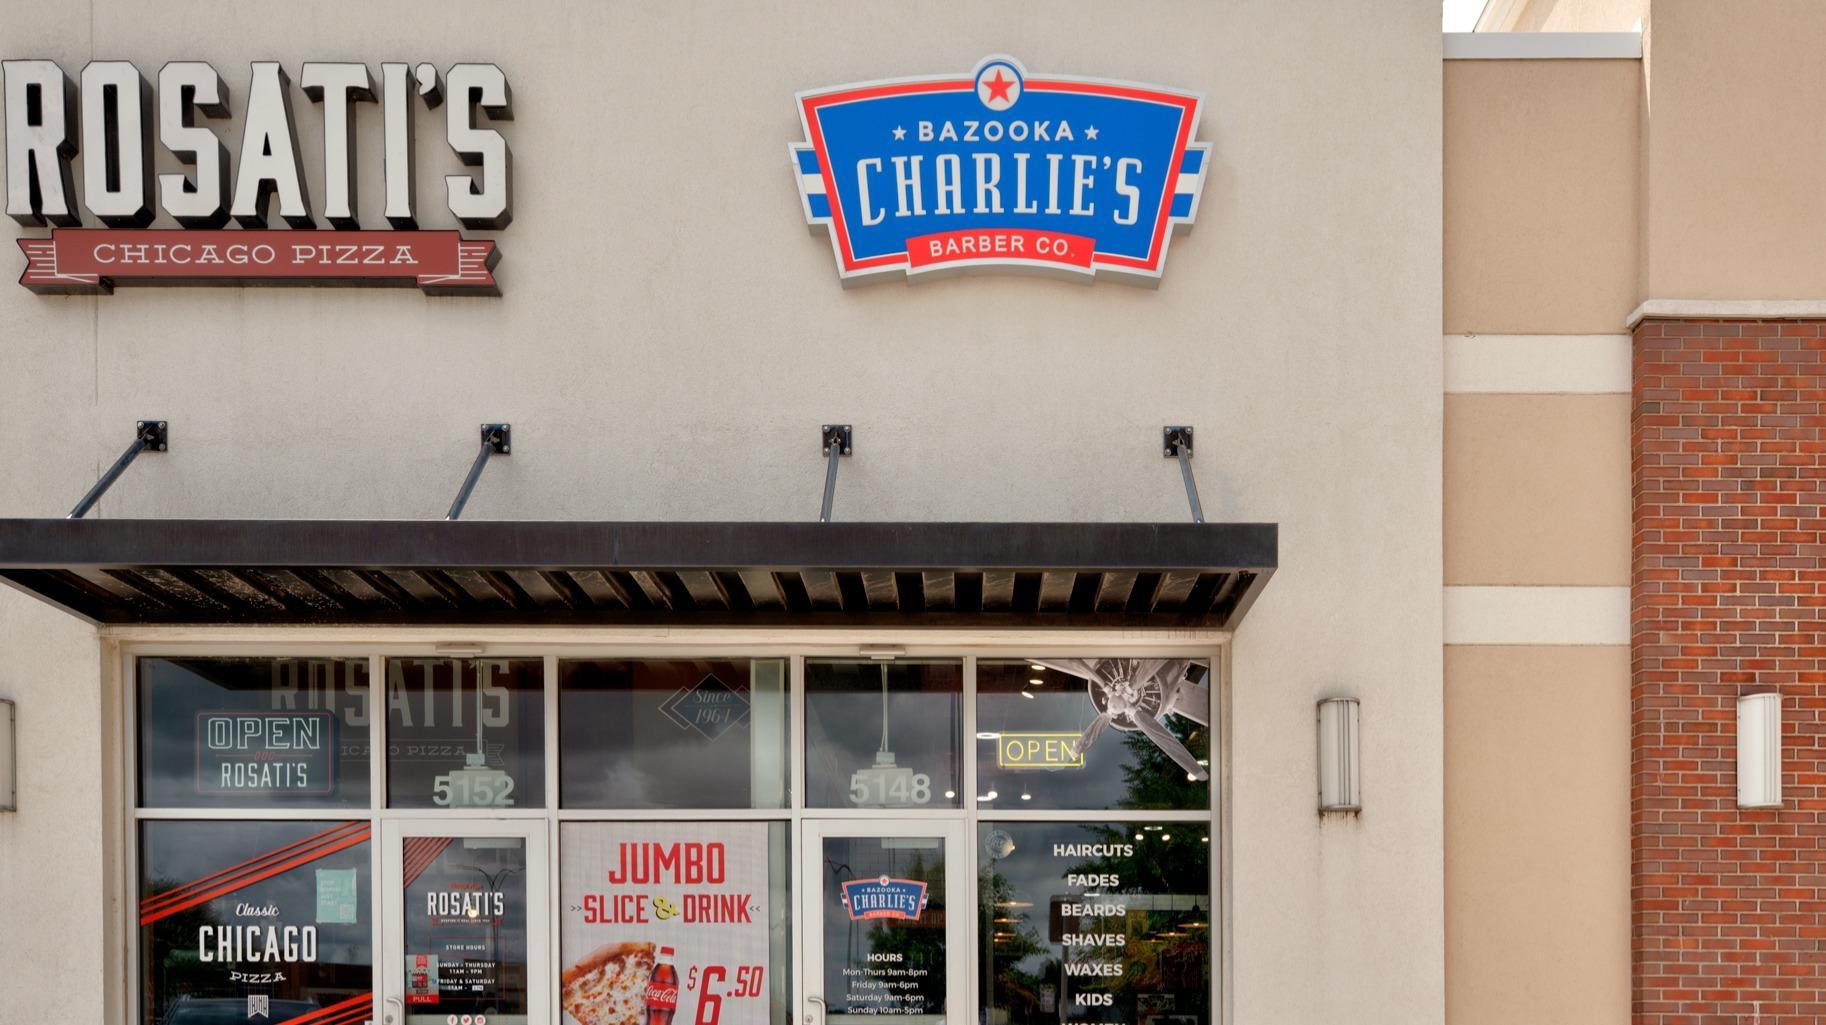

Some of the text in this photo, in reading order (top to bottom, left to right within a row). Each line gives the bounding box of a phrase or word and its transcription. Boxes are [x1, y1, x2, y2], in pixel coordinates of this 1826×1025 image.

[918, 120, 1074, 142] BAZOOKA
[2, 59, 511, 225] ROSATI'S
[856, 152, 1143, 226] CHARLIE'S
[93, 243, 419, 264] CHICAGO PIZZA
[929, 235, 1075, 257] BARBER CO.
[696, 689, 730, 703] Since
[208, 717, 320, 749] OPEN
[407, 745, 470, 756] PIZZA
[1006, 740, 1077, 761] OPEN
[221, 762, 307, 788] ROSATI'S
[432, 775, 515, 806] 5152
[849, 773, 931, 804] 5148
[1053, 844, 1133, 857] HAIRCUTS
[608, 842, 725, 885] JUMBO
[1067, 874, 1120, 887] FADES
[235, 902, 280, 917] Classic
[427, 891, 504, 916] ROSATI'S
[583, 894, 752, 923] SLICE & DRINK
[853, 893, 916, 911] CHARLIE'S
[1061, 904, 1126, 917] BEARDS
[199, 925, 317, 963] CHICAGO
[1061, 934, 1126, 947] SHAVES
[867, 953, 903, 962] HOURS
[229, 971, 287, 984] PIZZA
[842, 968, 928, 978] Mon-Thurs 9am-8pm
[1064, 963, 1123, 977] WAXES
[851, 980, 877, 990] Friday
[846, 993, 883, 1003] Saturday
[1075, 993, 1113, 1006] KIDS
[847, 1006, 880, 1015] Sunday
